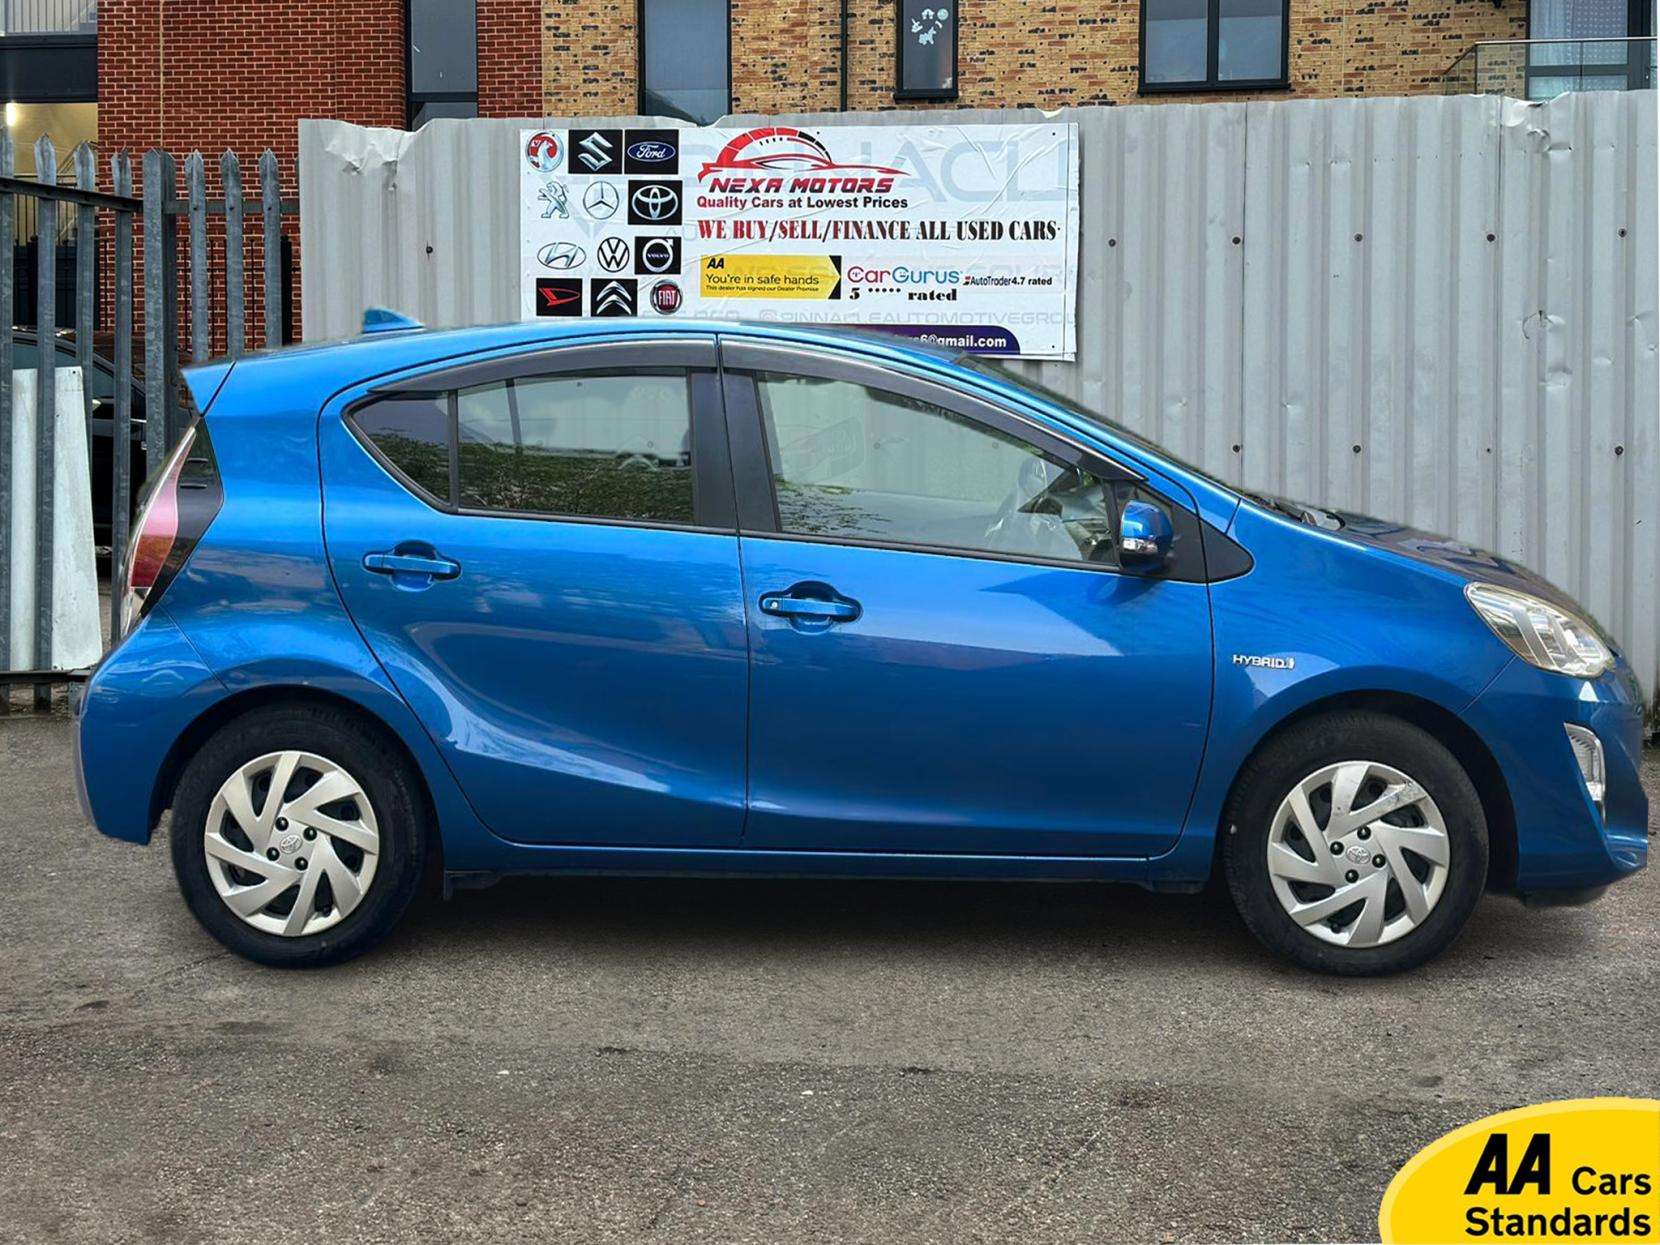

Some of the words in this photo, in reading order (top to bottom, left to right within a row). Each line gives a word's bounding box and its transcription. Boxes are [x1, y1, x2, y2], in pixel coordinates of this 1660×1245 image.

[636, 144, 666, 158] Ford
[709, 178, 783, 194] NEXA
[789, 178, 895, 194] MOTORS
[697, 196, 748, 211] Quality
[752, 196, 784, 209] Cars
[788, 196, 803, 209] at
[807, 196, 858, 209] Lowest
[863, 196, 908, 209] Prices
[697, 220, 727, 240] WE
[733, 220, 911, 242] BUY/SELL/FINANCE
[916, 220, 951, 240] ALL
[956, 220, 1003, 241] USED
[1008, 220, 1057, 241] CARS
[707, 257, 725, 269] AA
[706, 274, 741, 284] You're
[744, 274, 754, 284] in
[757, 274, 781, 284] safe
[784, 275, 819, 285] hands
[847, 266, 960, 284] CarGurus
[1028, 276, 1053, 286] rated
[658, 290, 677, 306] FIAT
[849, 288, 861, 300] 5
[908, 288, 958, 301] rated
[1232, 654, 1285, 668] HYBRID
